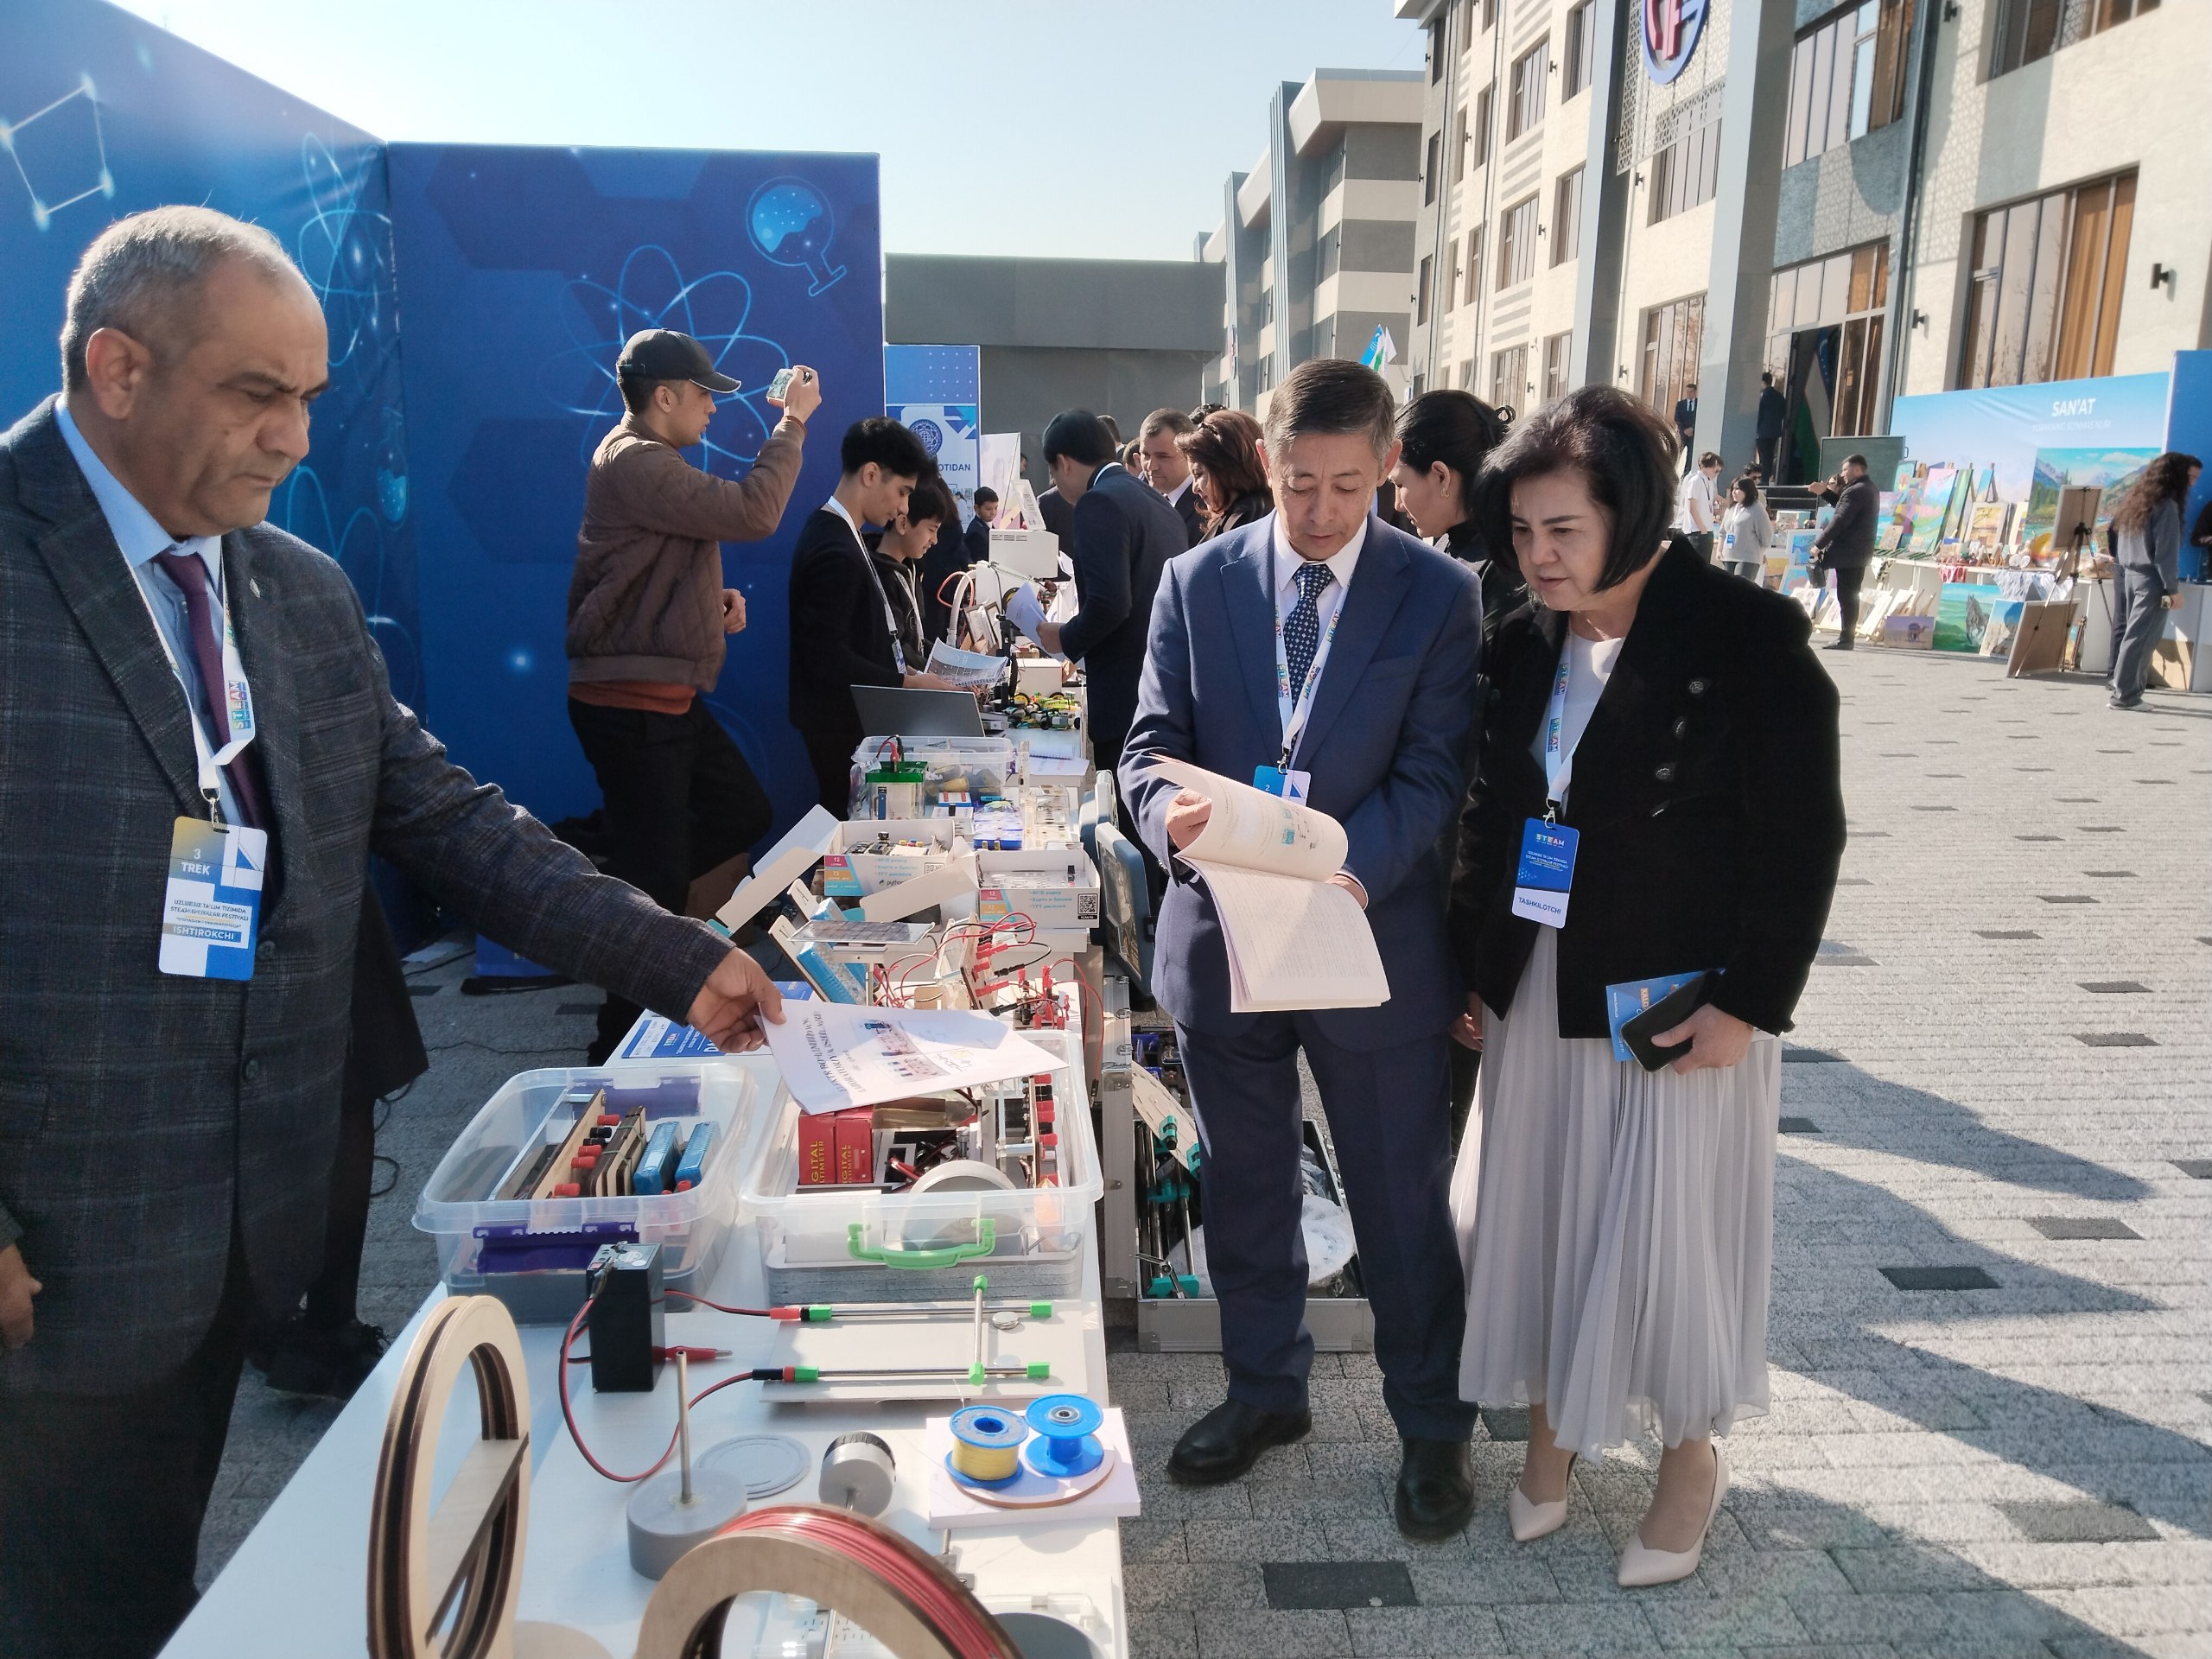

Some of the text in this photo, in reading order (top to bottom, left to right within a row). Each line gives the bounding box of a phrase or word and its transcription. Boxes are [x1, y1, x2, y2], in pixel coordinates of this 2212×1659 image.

[2051, 397, 2096, 416] SAN'AT
[1279, 664, 1289, 698] STEAM
[229, 680, 245, 729] STEAM
[1536, 834, 1565, 847] STEAM
[194, 849, 201, 860] 3
[181, 861, 211, 875] TREK
[222, 906, 246, 914] TIZIMIDA
[1518, 897, 1561, 914] TASHKILOTCHI
[221, 912, 249, 922] FESTIVALI
[173, 926, 235, 941] ISHTIROKCHI
[810, 1141, 819, 1182] GITAL
